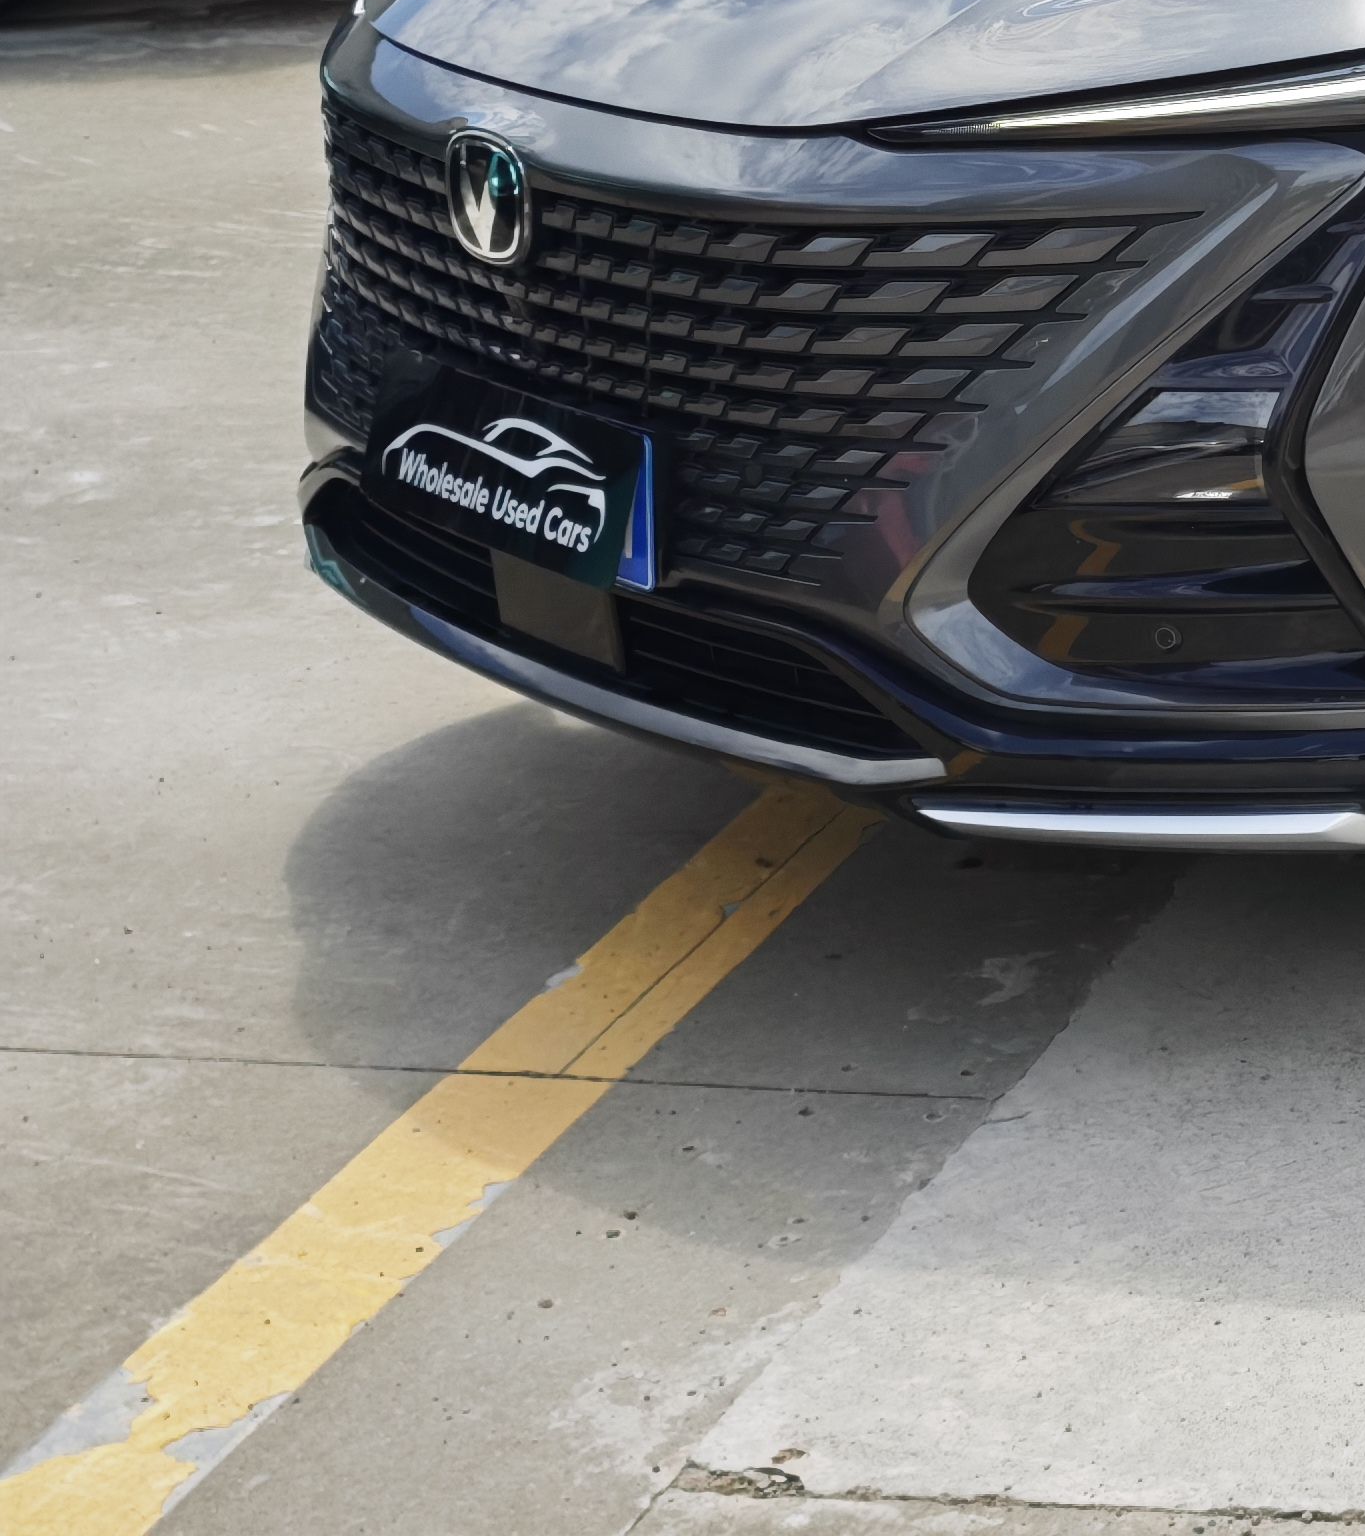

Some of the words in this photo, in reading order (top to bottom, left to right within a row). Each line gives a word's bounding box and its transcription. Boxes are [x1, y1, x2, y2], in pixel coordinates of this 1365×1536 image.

[398, 447, 489, 514] Wholesale
[491, 485, 545, 534] Used
[543, 506, 593, 553] Cars
